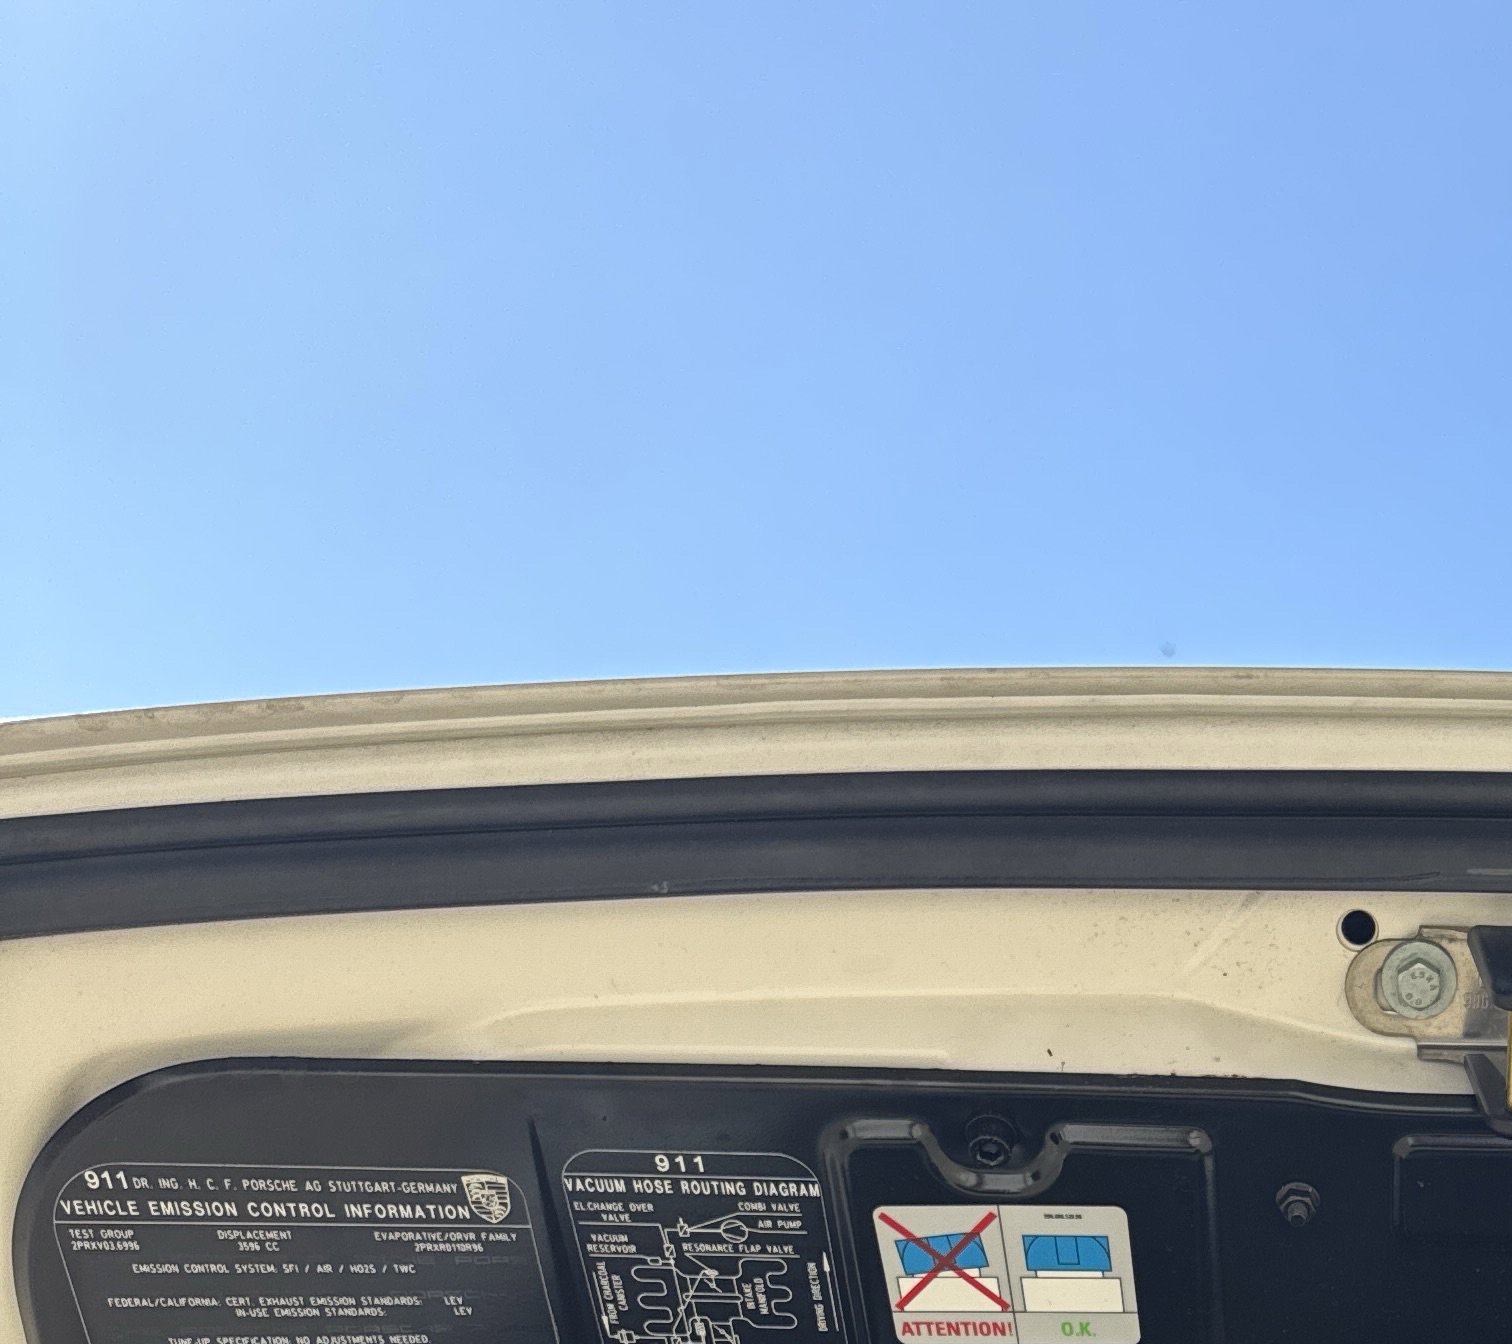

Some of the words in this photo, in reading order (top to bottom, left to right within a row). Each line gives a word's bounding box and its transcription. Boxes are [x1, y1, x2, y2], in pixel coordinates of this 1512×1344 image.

[654, 1154, 704, 1172] 911
[84, 1170, 128, 1190] 911
[158, 1177, 182, 1190] ING.
[242, 1179, 298, 1192] PORSCHE
[305, 1180, 322, 1192] AG
[328, 1180, 458, 1194] STUTTGART-GERMANY
[563, 1178, 626, 1193] VACUUM
[632, 1179, 674, 1194] HOSE
[680, 1180, 746, 1196] ROUTING
[753, 1182, 820, 1197] DIAGRAM
[59, 1200, 140, 1216] VEHICLE
[148, 1200, 238, 1217] EMISSION
[247, 1202, 335, 1218] CONTROL
[344, 1203, 471, 1220] INFORMATION
[629, 1202, 654, 1212] OVER
[771, 1202, 800, 1212] VALVE
[601, 1213, 632, 1222] VALVE
[758, 1219, 772, 1229] AIR
[777, 1220, 802, 1229] PUMP
[68, 1229, 94, 1239] TEST
[100, 1229, 134, 1240] GROUP
[217, 1230, 292, 1240] DISPLACEMENT
[480, 1232, 518, 1242] FAMILY
[590, 1233, 629, 1242] VACUUM
[265, 1242, 280, 1251] CC
[586, 1243, 637, 1253] RESERVOIR
[738, 1244, 761, 1253] FLAP
[766, 1244, 794, 1254] VALVE
[132, 1263, 180, 1274] EMISSION
[183, 1263, 230, 1273] CONTROL
[258, 1296, 304, 1306] EXHAUST
[310, 1296, 356, 1306] EMISSION
[273, 1307, 320, 1317] EMISSION
[901, 1321, 1014, 1337] ATTENTION!
[1061, 1322, 1097, 1337] O.K.
[316, 1335, 385, 1344] ADJUSTMENTS
